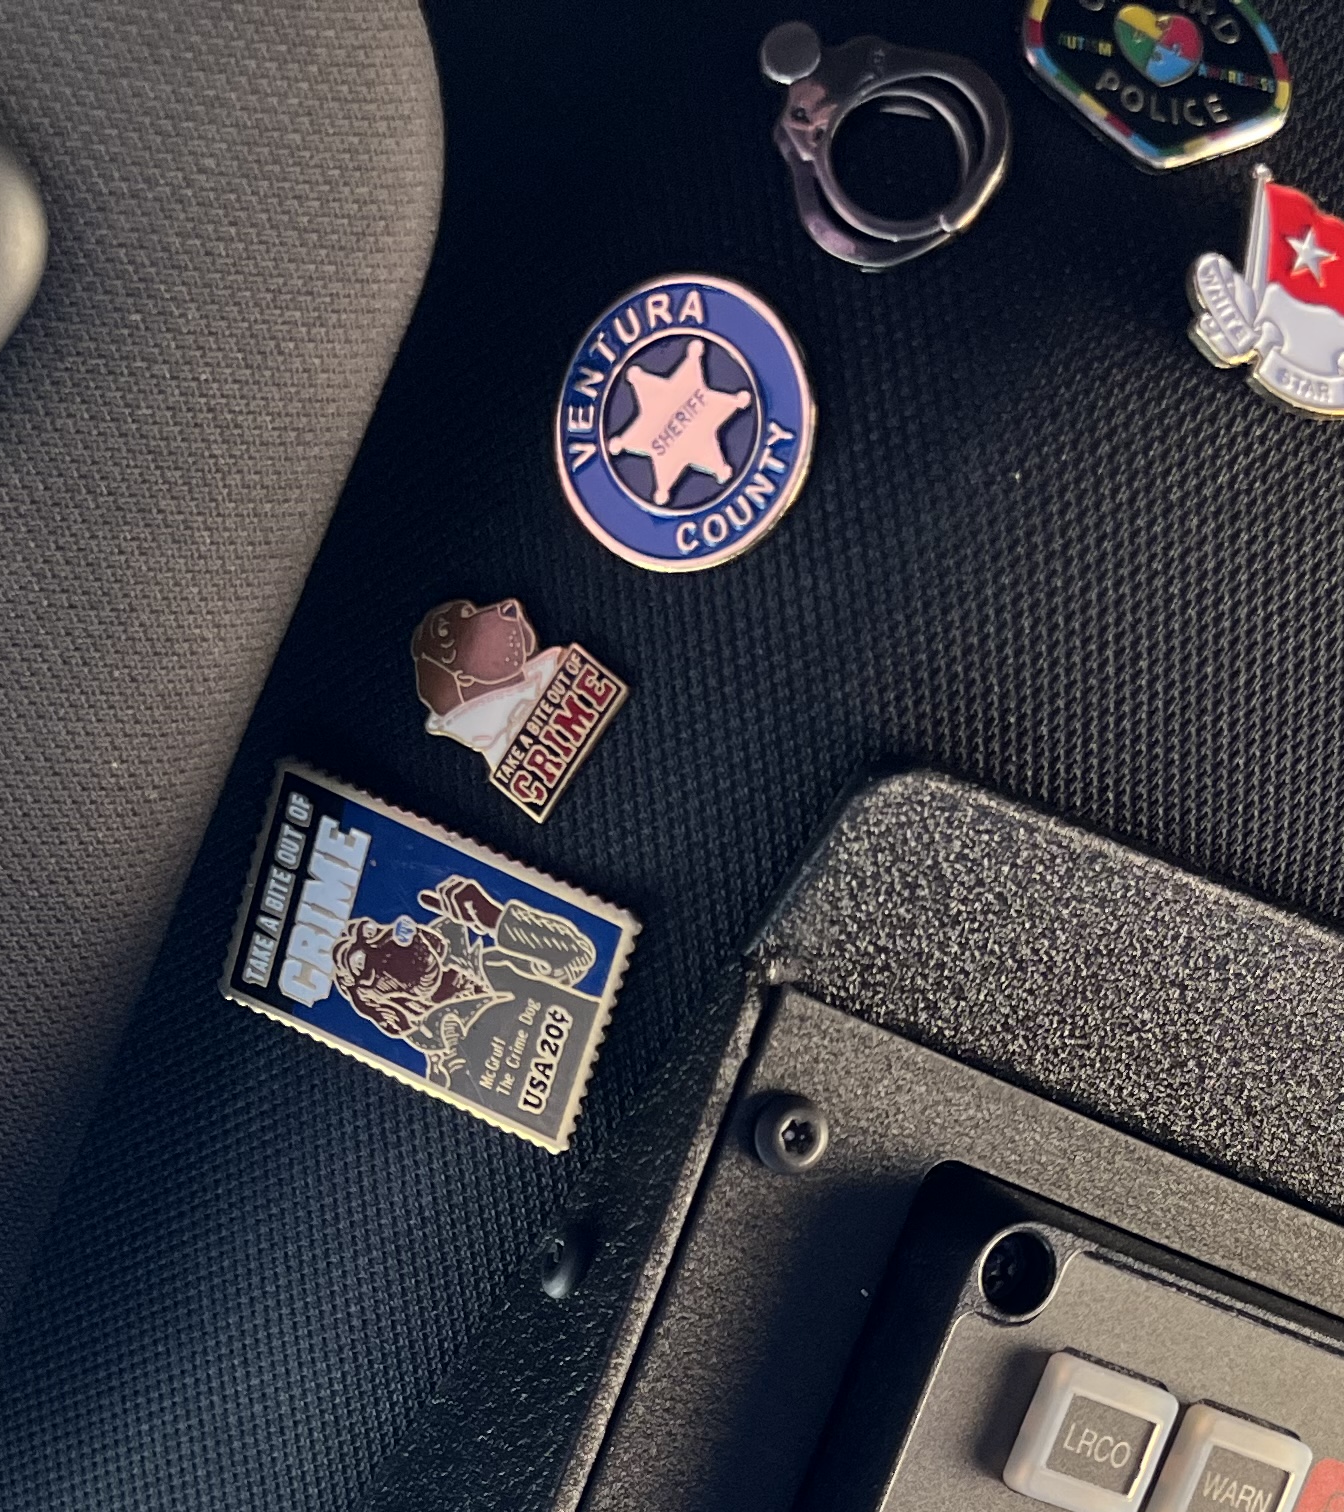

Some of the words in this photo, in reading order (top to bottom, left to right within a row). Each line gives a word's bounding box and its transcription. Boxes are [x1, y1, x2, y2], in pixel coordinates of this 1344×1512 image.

[1095, 70, 1230, 127] POLICE
[1204, 268, 1250, 347] WHITE
[568, 289, 705, 472] VENTURA
[1276, 371, 1330, 401] STAR
[651, 388, 706, 457] SHERIFF
[674, 421, 796, 555] COUNTY
[495, 749, 525, 784] TAKE
[519, 735, 533, 750] A
[527, 703, 553, 737] BITE
[546, 672, 572, 706] OUT
[565, 654, 585, 676] OF
[510, 664, 618, 806] CRIME
[287, 793, 313, 827] OF
[276, 824, 307, 870] OUT
[264, 867, 296, 915] BITE
[278, 815, 372, 1007] CRIME
[264, 908, 283, 935] A
[243, 929, 277, 987] TAKE
[479, 1036, 506, 1090] McGruff
[496, 1070, 516, 1096] The
[506, 1029, 529, 1070] Crime
[518, 998, 542, 1026] Dog
[1063, 1423, 1132, 1469] LRCO
